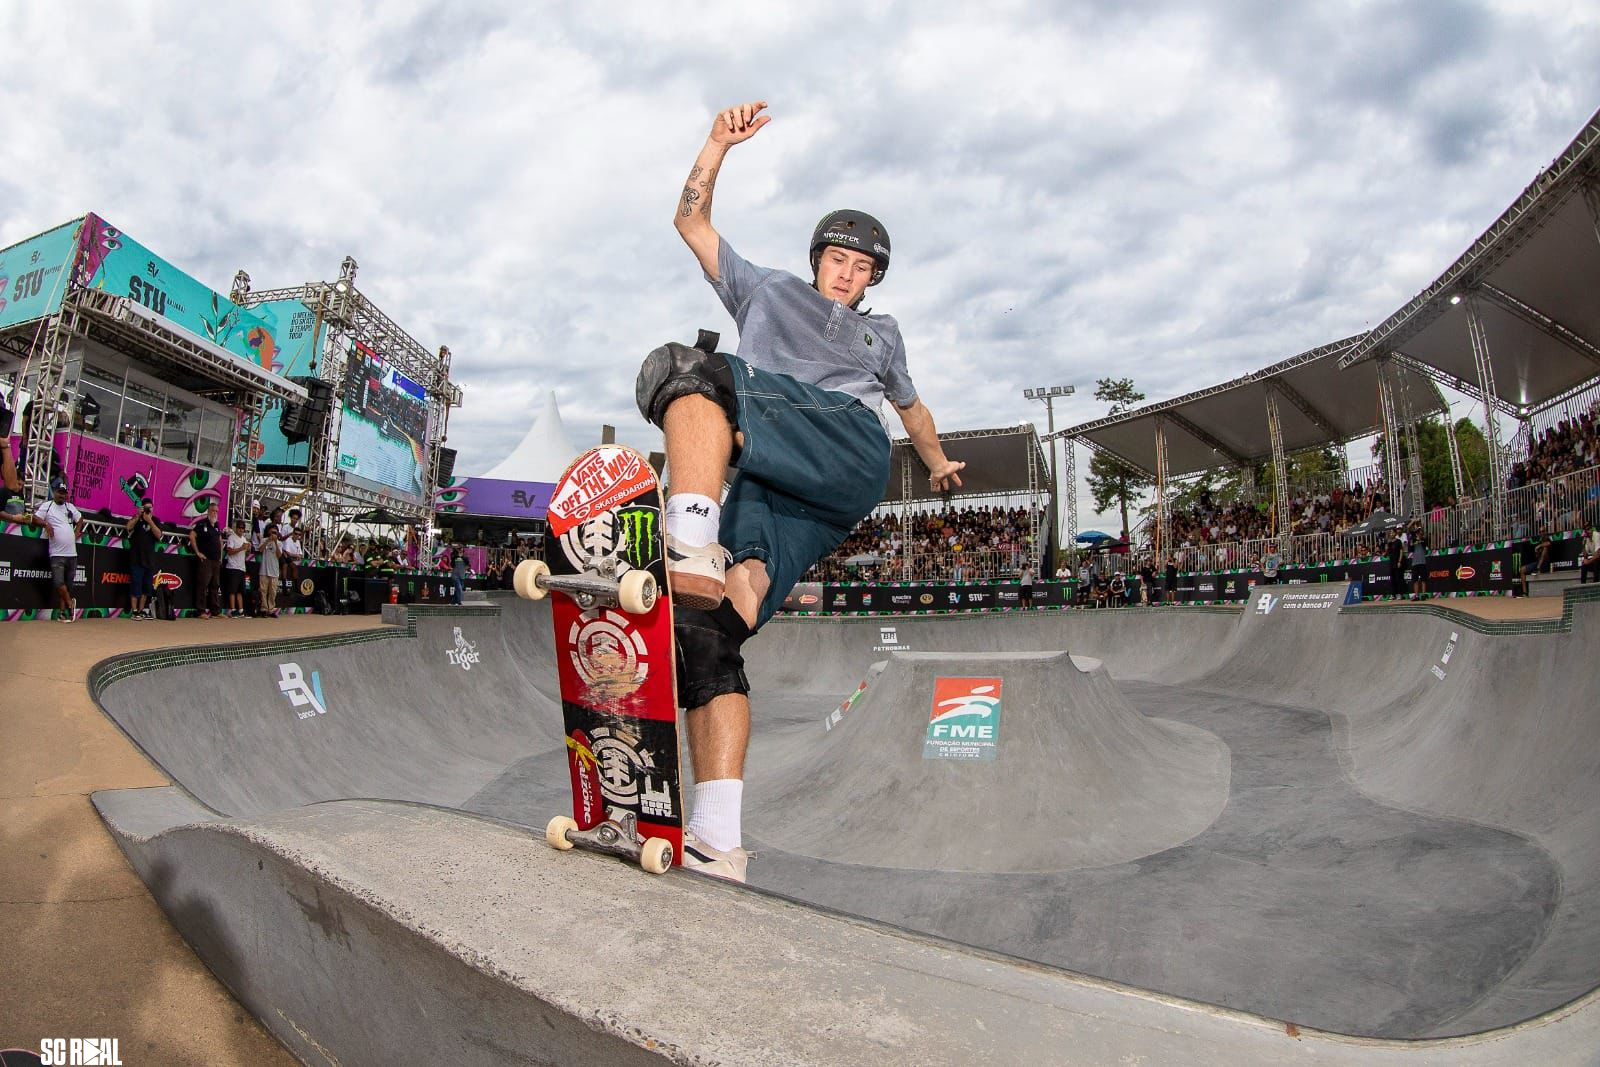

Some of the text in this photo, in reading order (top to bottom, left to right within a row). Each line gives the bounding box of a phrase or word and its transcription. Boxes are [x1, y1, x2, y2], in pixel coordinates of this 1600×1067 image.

[13, 267, 46, 302] STU
[128, 275, 167, 316] STU
[84, 450, 110, 466] MELHOR
[87, 463, 106, 479] SKATE
[570, 455, 605, 487] VANS
[82, 474, 103, 490] TEMPO
[580, 470, 610, 500] THE
[511, 489, 536, 508] BV
[13, 569, 53, 579] PETROBRAS
[446, 648, 480, 670] Tiger
[278, 662, 328, 714] BV
[297, 710, 316, 720] banco
[933, 724, 994, 739] FME
